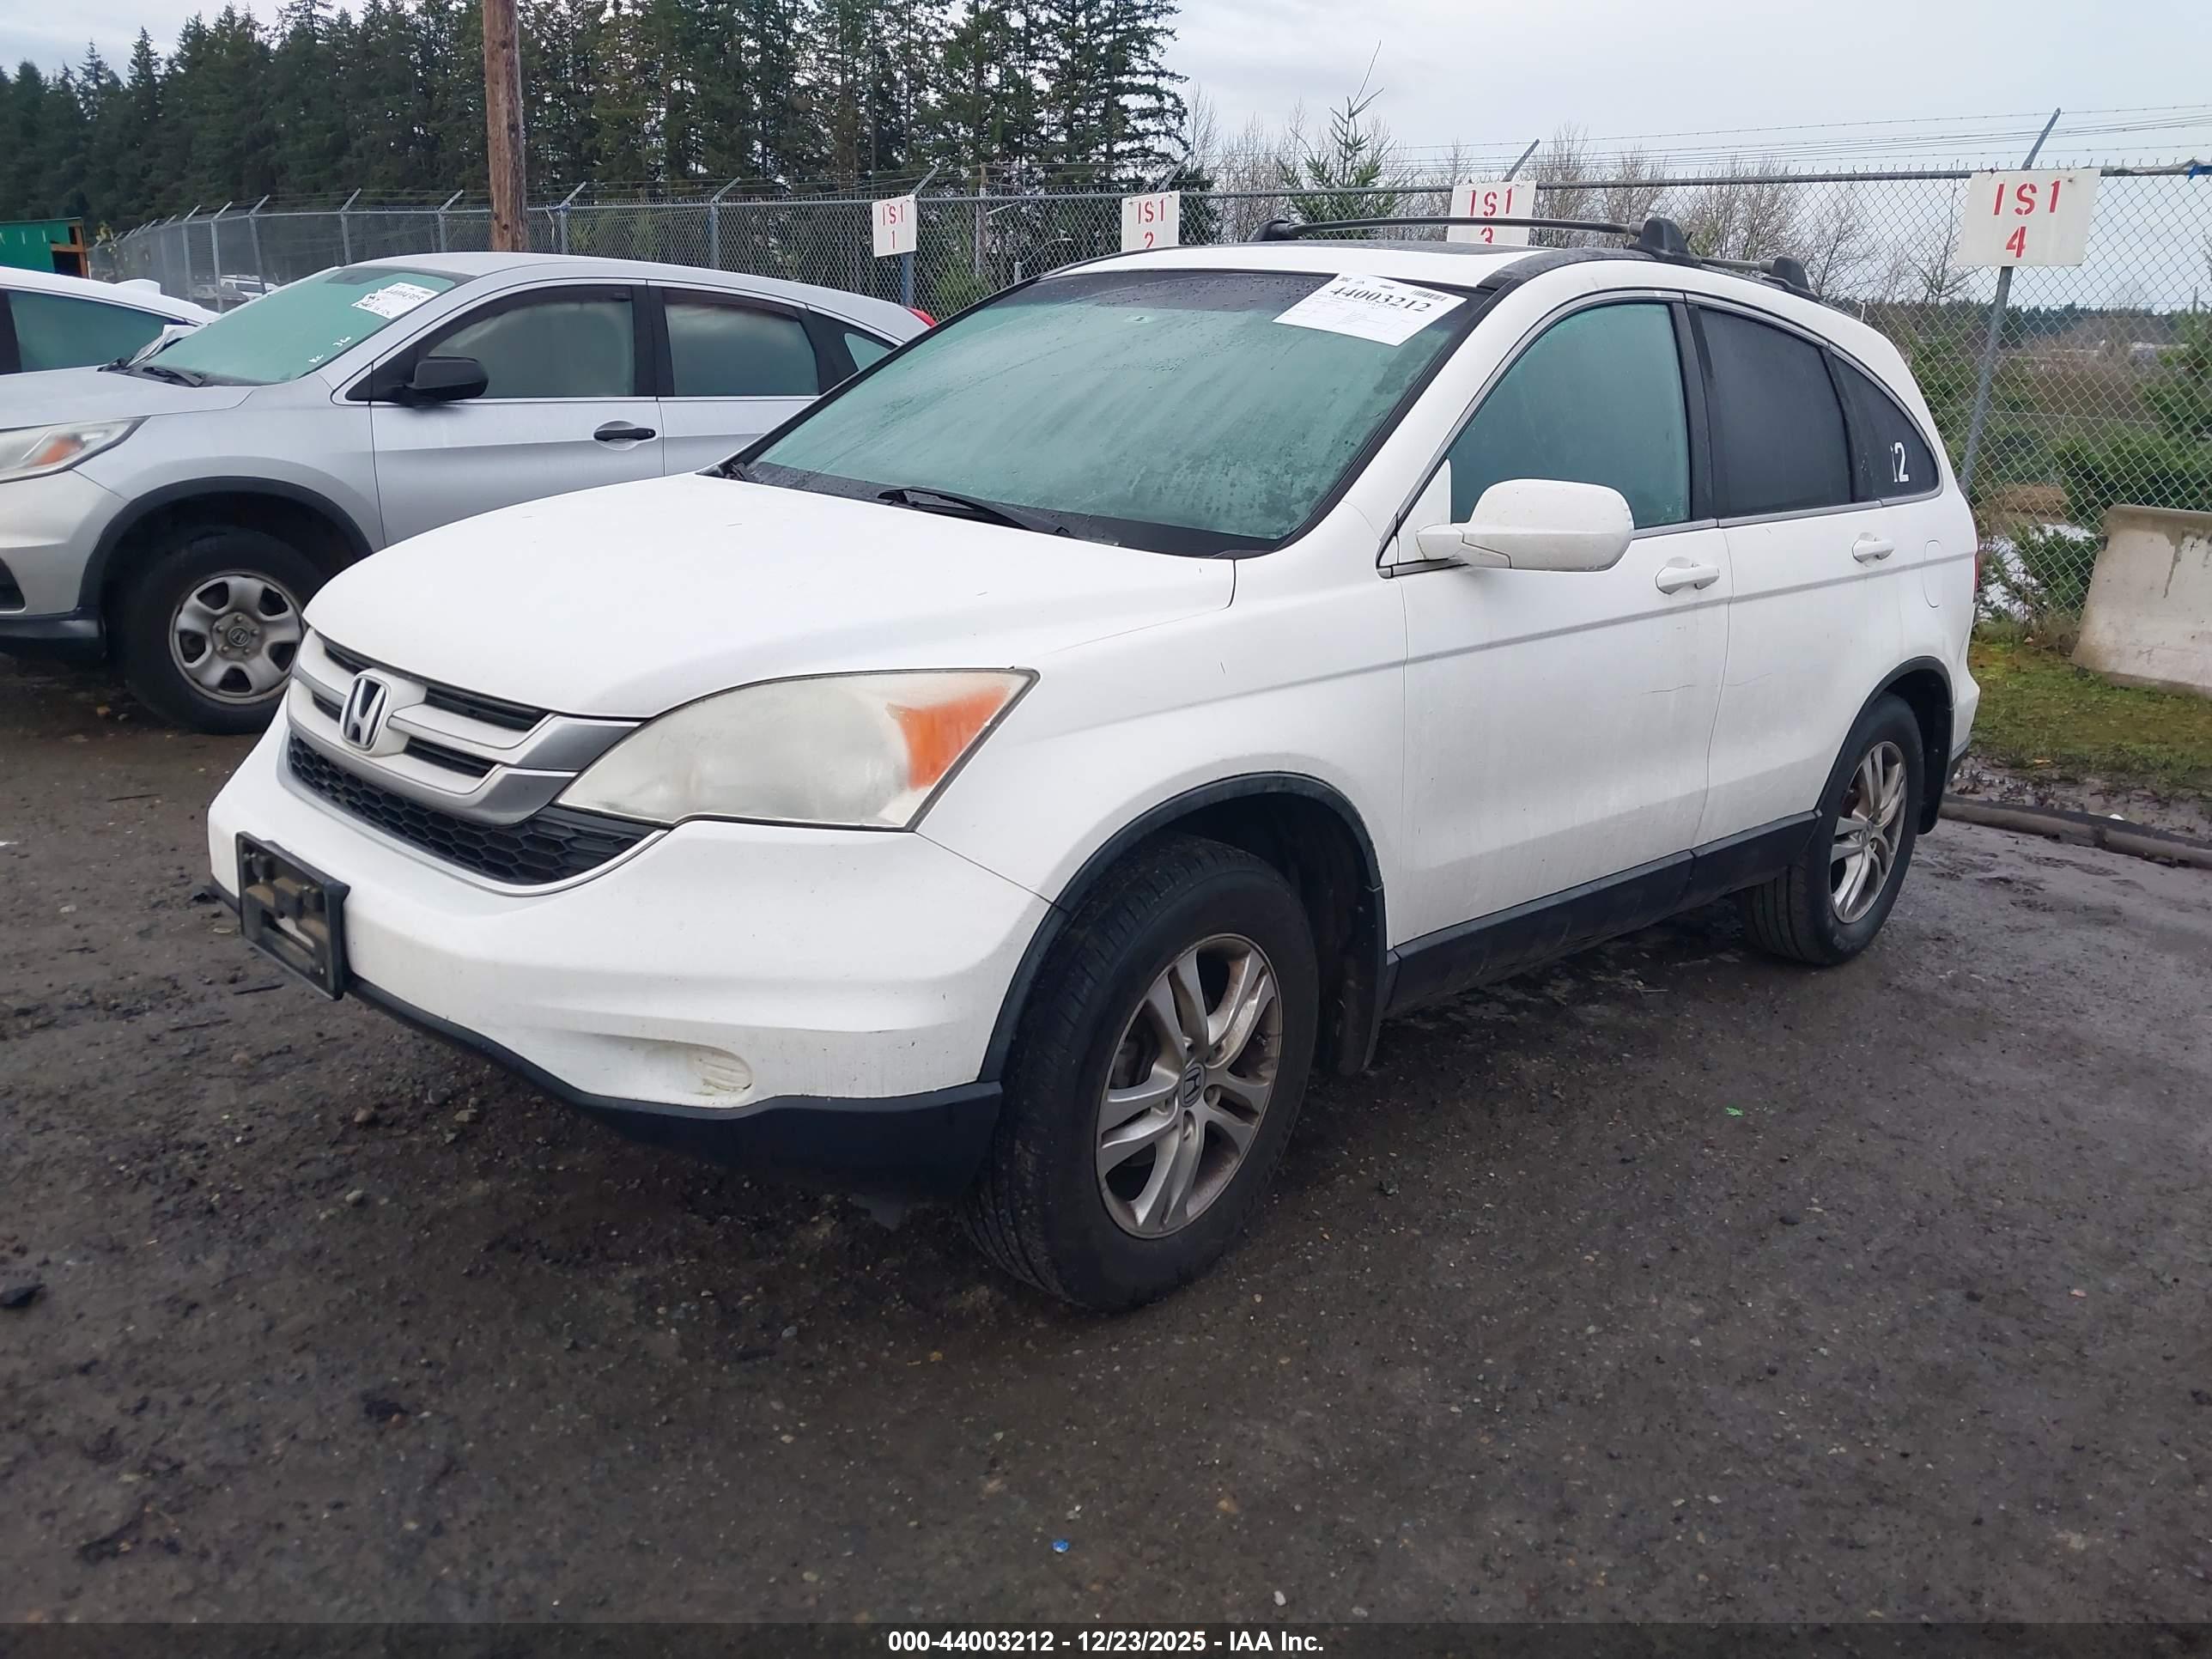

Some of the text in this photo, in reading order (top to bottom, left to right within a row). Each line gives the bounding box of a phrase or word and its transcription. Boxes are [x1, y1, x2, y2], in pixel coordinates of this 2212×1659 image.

[1145, 231, 1154, 249] 2
[2006, 226, 2027, 258] 4
[1330, 286, 1432, 313] 44003212
